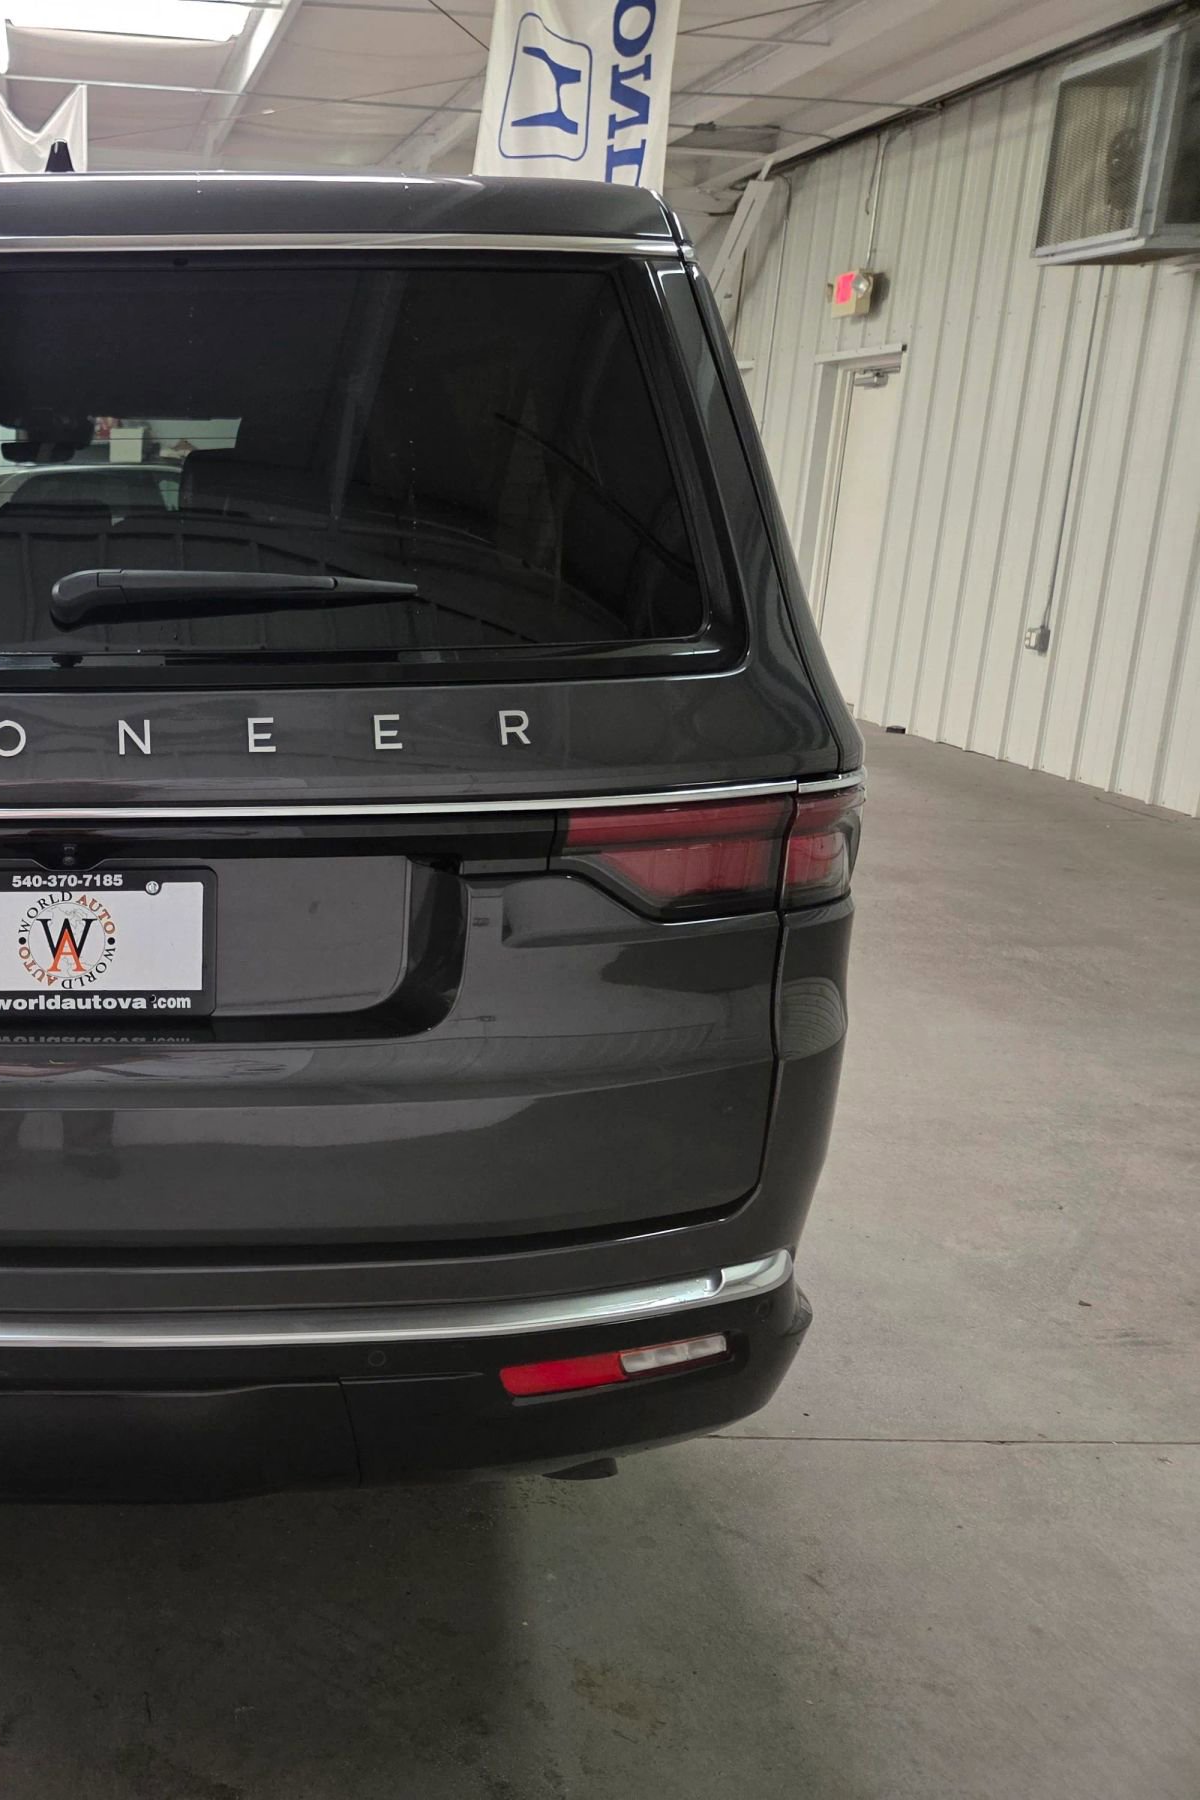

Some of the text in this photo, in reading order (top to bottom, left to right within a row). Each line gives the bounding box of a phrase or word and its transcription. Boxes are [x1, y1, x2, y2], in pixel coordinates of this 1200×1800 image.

[11, 874, 124, 888] 540-370-7185
[18, 890, 116, 935] WORLD AUTO
[18, 946, 117, 990] WORLD AUTO
